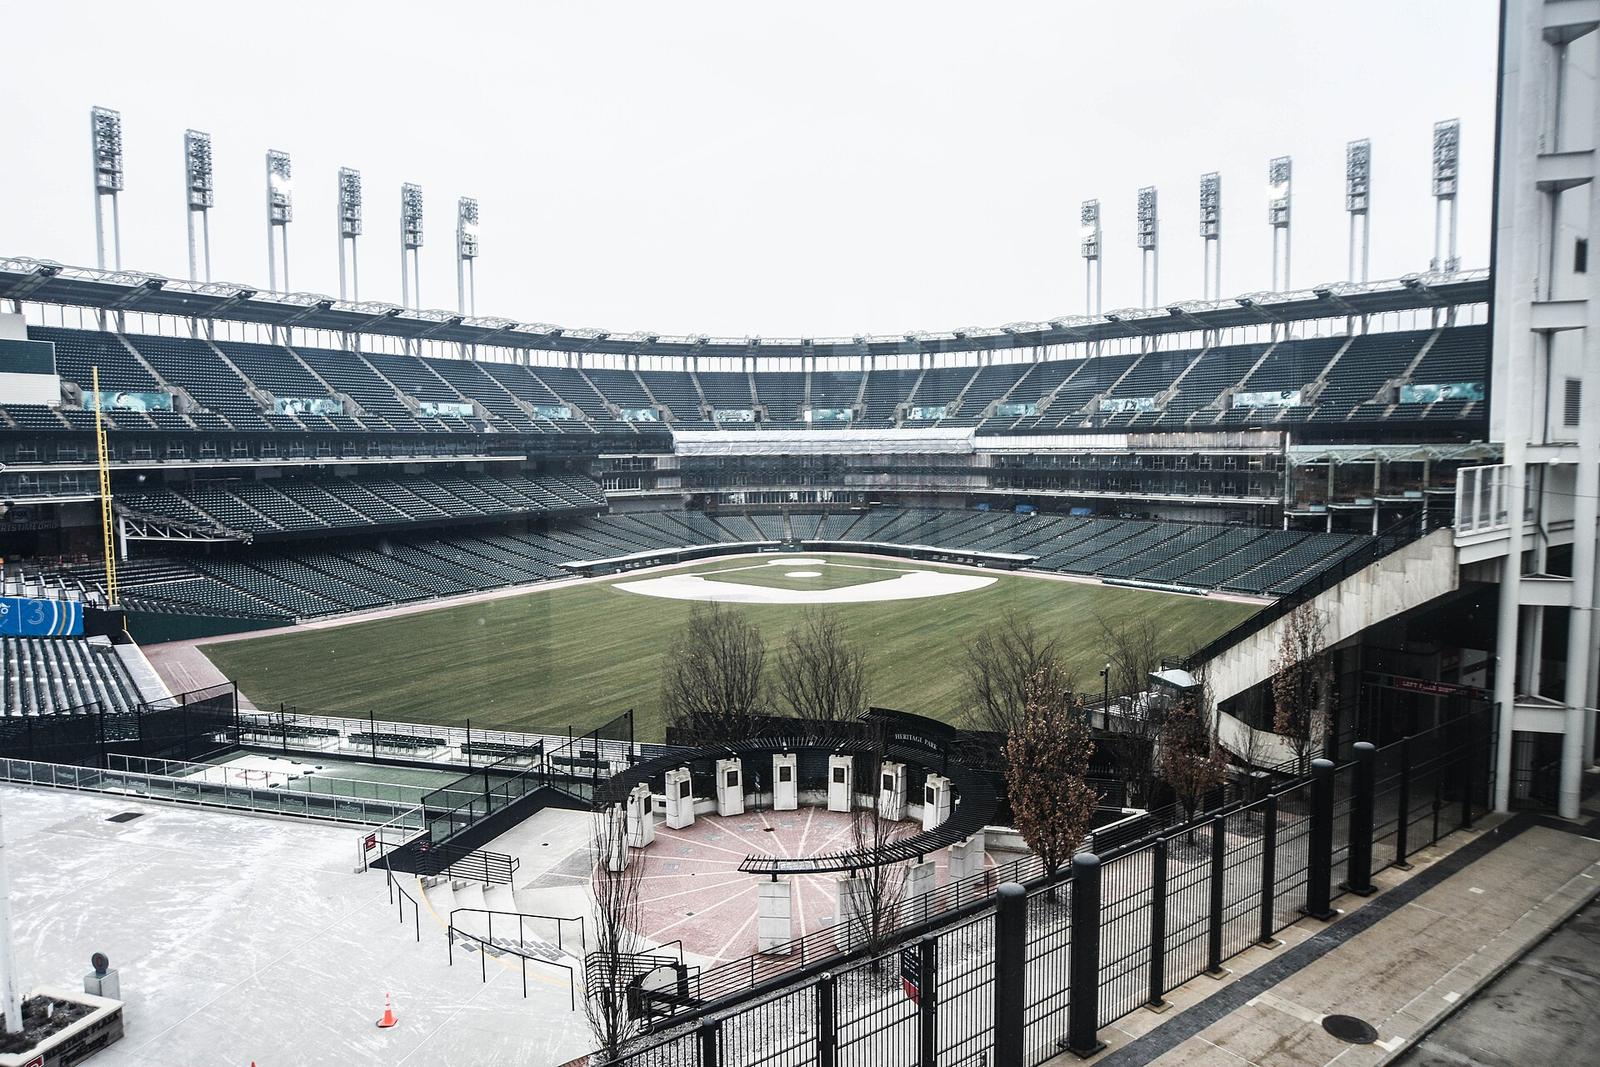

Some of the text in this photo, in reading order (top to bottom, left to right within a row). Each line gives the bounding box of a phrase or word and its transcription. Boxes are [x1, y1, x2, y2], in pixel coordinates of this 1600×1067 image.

[27, 599, 45, 625] 3
[895, 733, 938, 751] HERITAGE PARK
